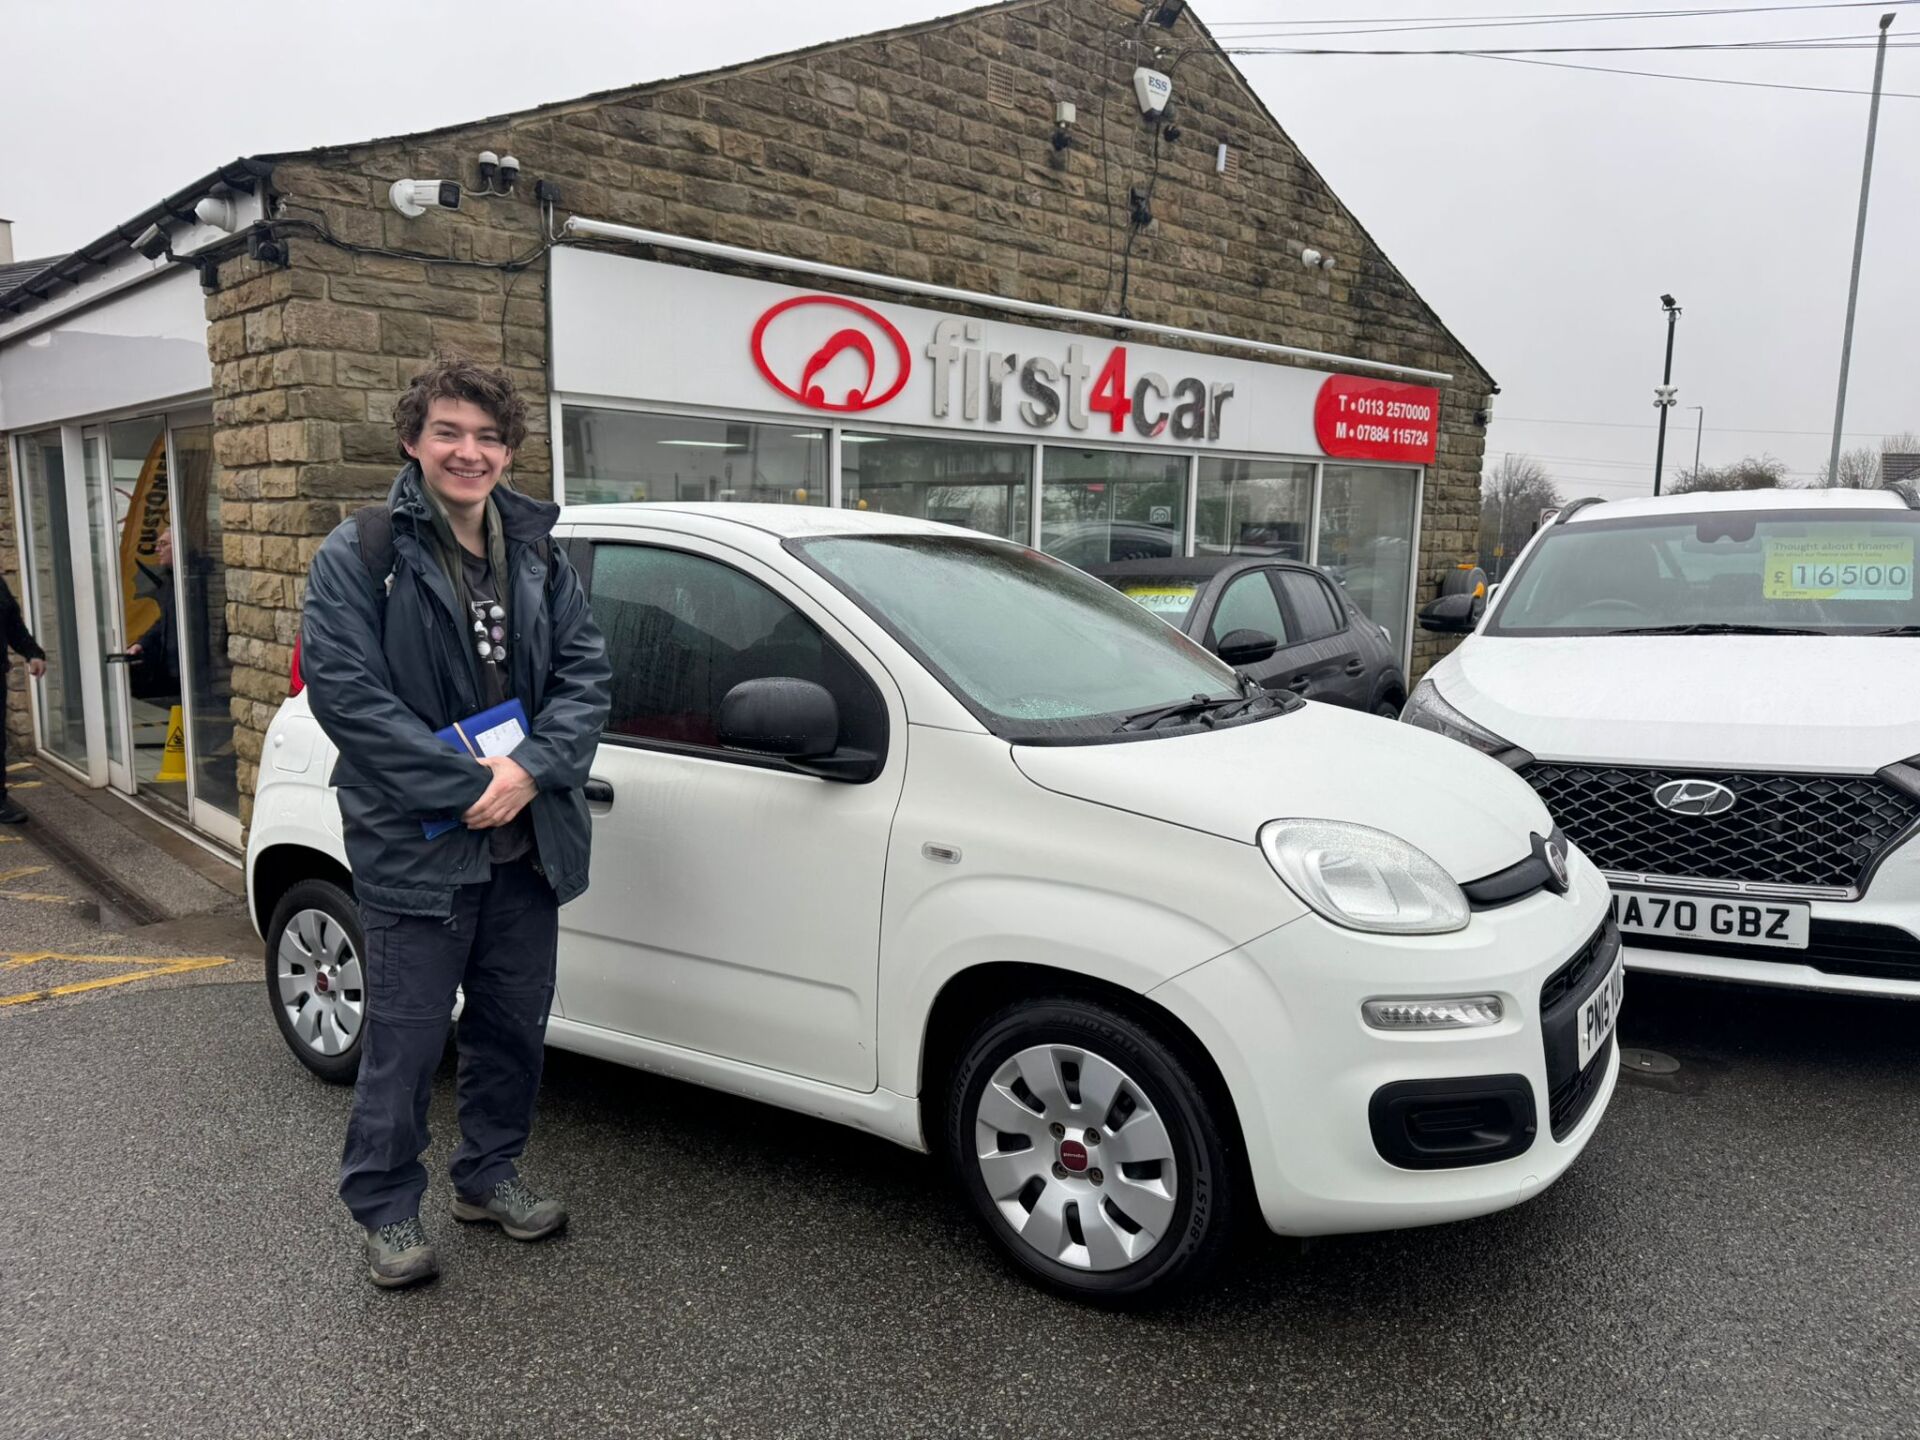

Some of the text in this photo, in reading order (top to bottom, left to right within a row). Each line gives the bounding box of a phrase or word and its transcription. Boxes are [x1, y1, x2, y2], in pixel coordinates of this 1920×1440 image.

[1148, 75, 1168, 92] ESS
[926, 318, 1235, 441] first4car
[1338, 394, 1431, 421] T 0113 2570000
[1335, 421, 1429, 446] M 07884 115724
[1821, 542, 1853, 551] about
[1774, 565, 1907, 586] £ 16500
[1710, 903, 1790, 940] GBZ
